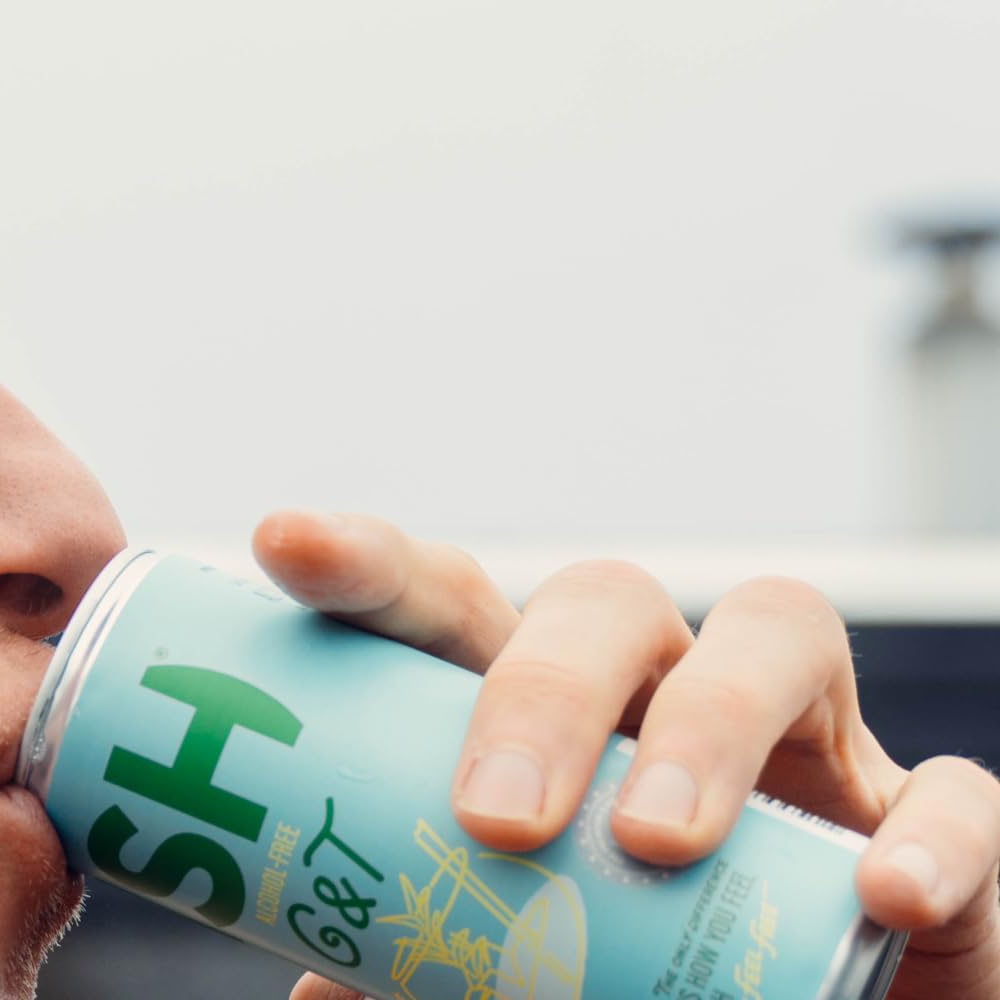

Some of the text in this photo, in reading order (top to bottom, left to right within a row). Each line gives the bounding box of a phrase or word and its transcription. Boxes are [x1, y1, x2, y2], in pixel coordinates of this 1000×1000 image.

[255, 821, 301, 927] ALCOHOL-FREE
[287, 797, 385, 968] G&T
[685, 942, 719, 990] HOW
[703, 906, 737, 943] YOU
[720, 871, 759, 908] FEEL
